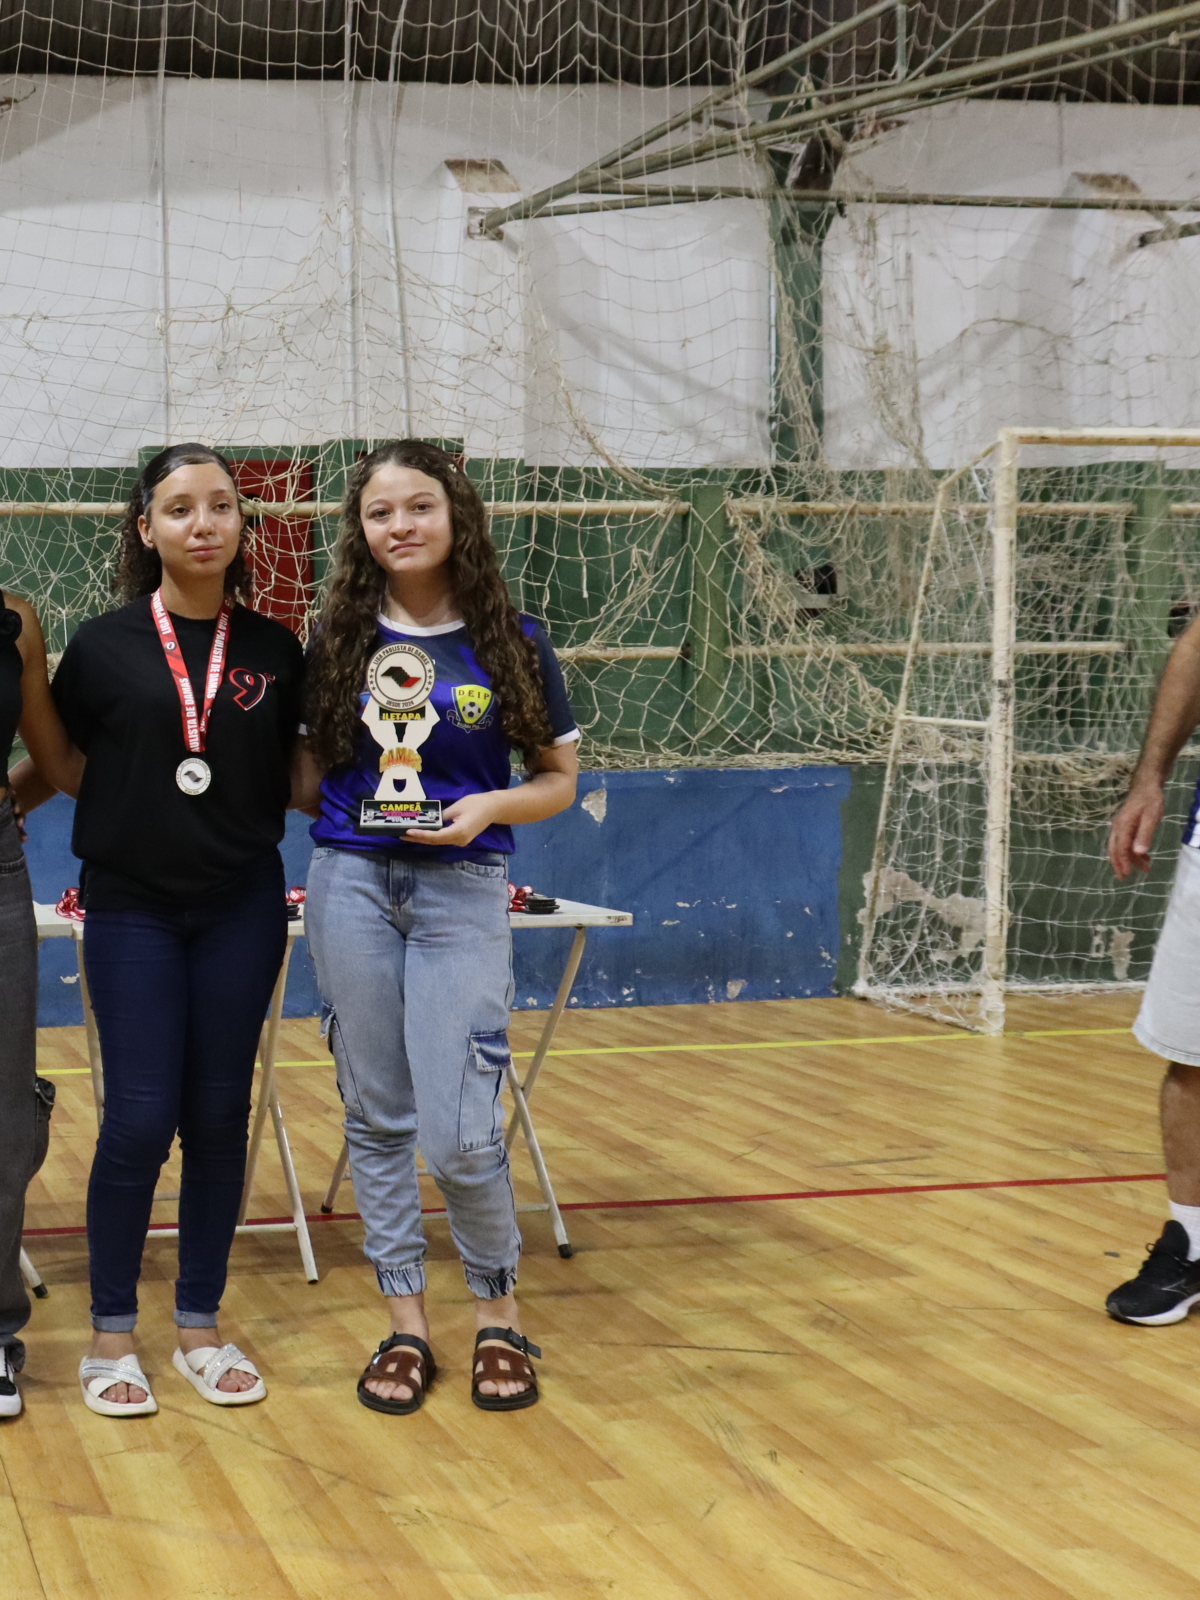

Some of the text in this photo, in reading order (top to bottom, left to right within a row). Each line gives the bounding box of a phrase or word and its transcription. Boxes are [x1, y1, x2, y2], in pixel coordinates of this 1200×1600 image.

[158, 616, 172, 635] LIGA
[206, 612, 229, 699] LIGA PAULISTA DE DAMAS
[373, 653, 384, 665] LIGA
[383, 645, 407, 656] PAULISTA
[414, 650, 430, 665] DAMAS
[179, 677, 195, 706] DAMAS
[386, 700, 415, 708] DESDE 2024
[185, 706, 197, 718] DE
[390, 712, 422, 720] ETAPA
[380, 802, 422, 812] CAMPEÃ
